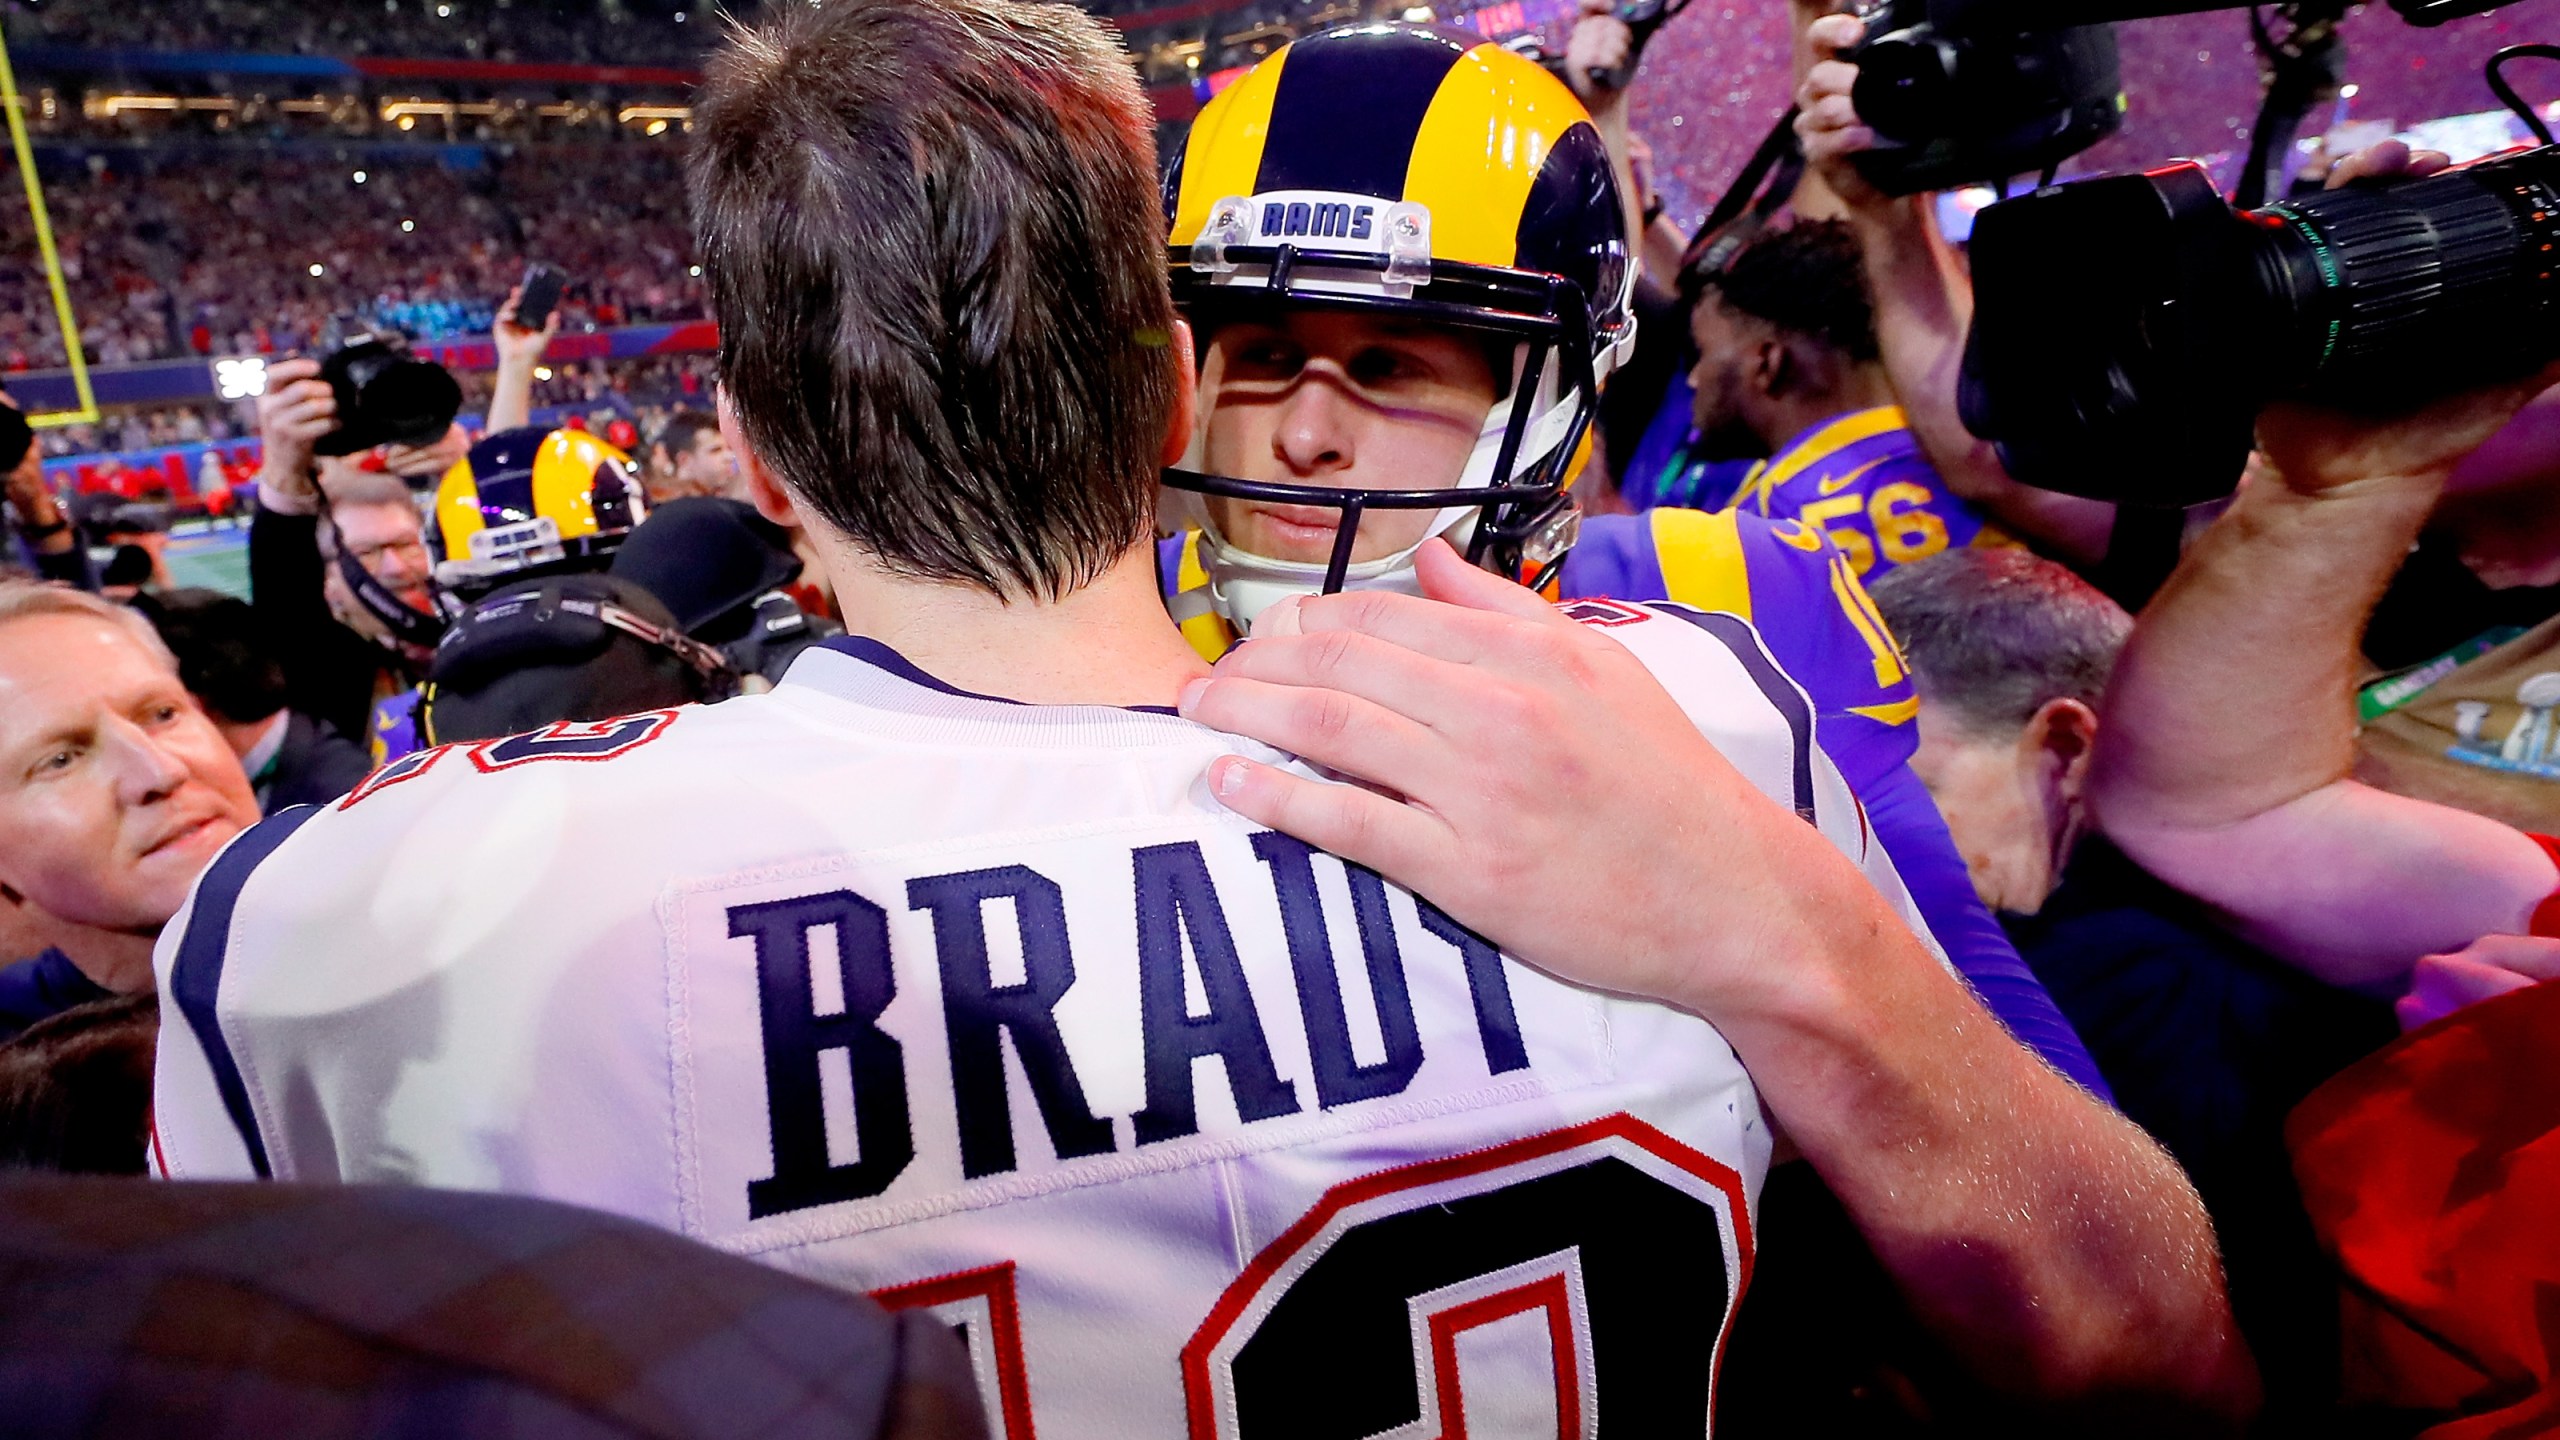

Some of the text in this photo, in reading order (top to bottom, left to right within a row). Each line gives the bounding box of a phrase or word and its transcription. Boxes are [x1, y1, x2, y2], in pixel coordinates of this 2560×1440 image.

[1261, 202, 1374, 240] RAMS
[2298, 221, 2323, 244] JAPAN
[2321, 259, 2339, 288] MADE
[1801, 481, 1949, 577] 56
